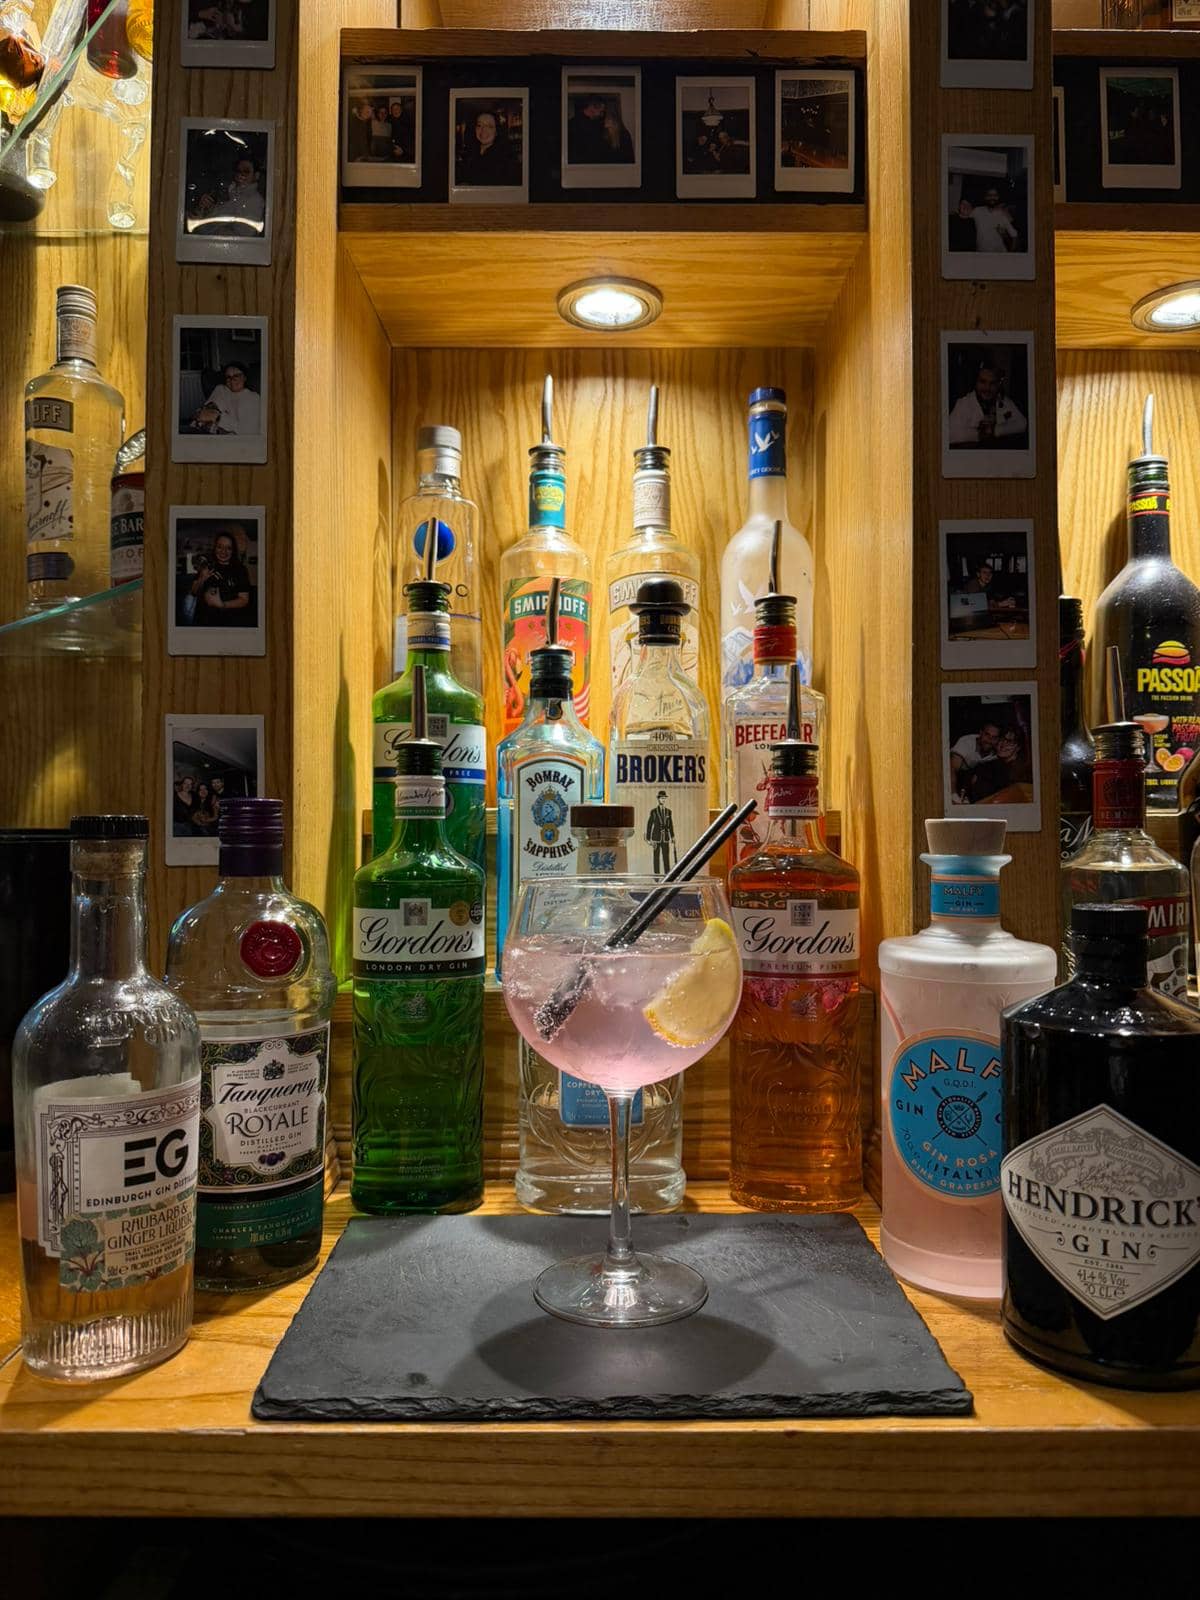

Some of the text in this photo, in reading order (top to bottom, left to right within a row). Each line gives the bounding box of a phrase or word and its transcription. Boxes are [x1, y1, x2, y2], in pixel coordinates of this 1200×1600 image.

[526, 770, 575, 792] BOMBAY
[616, 753, 706, 784] BROKER'S
[523, 837, 577, 858] SAPPHIRE
[360, 916, 474, 955] Gordon's
[743, 916, 855, 955] Gordon's
[366, 963, 412, 972] LONDON
[449, 961, 468, 970] GIN
[760, 962, 844, 970] PREMIUM PINK
[901, 1047, 1001, 1092] MALF
[219, 1078, 317, 1106] Tanqueray
[225, 1106, 309, 1138] ROYALE
[895, 1100, 924, 1116] GIN
[240, 1135, 286, 1147] DISTILLED
[922, 1141, 948, 1162] GIN
[956, 1149, 997, 1169] ROSA
[124, 1128, 189, 1188] EG
[911, 1159, 1001, 1190] PINK GRAPEFRU
[86, 1190, 152, 1208] EDINBURGH
[155, 1184, 171, 1196] GIN
[121, 1206, 179, 1234] RHUBARB
[107, 1228, 156, 1250] GINGER
[1072, 1234, 1142, 1260] GIN
